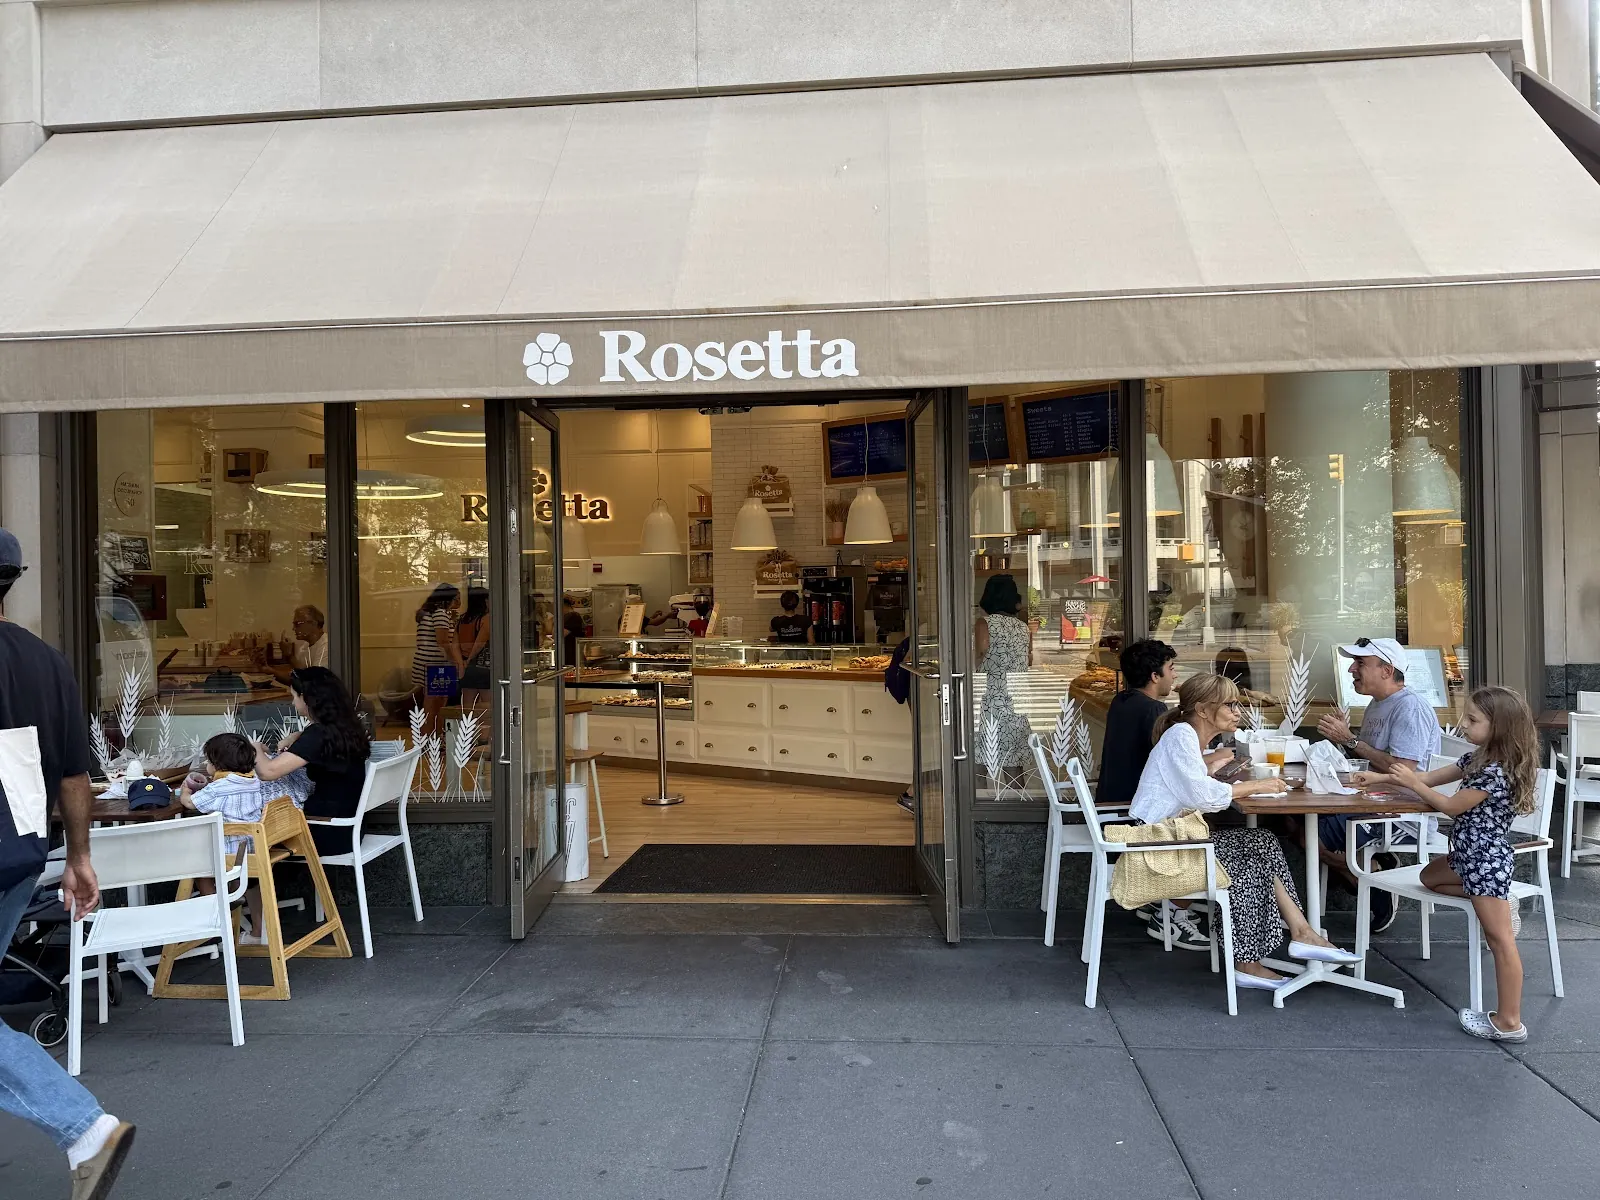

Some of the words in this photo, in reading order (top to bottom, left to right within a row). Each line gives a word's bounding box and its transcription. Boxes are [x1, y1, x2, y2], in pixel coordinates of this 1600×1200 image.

[599, 329, 859, 382] Rosetta
[754, 489, 783, 497] Rosetta
[460, 493, 610, 522] Retta
[762, 571, 793, 579] Rosetta
